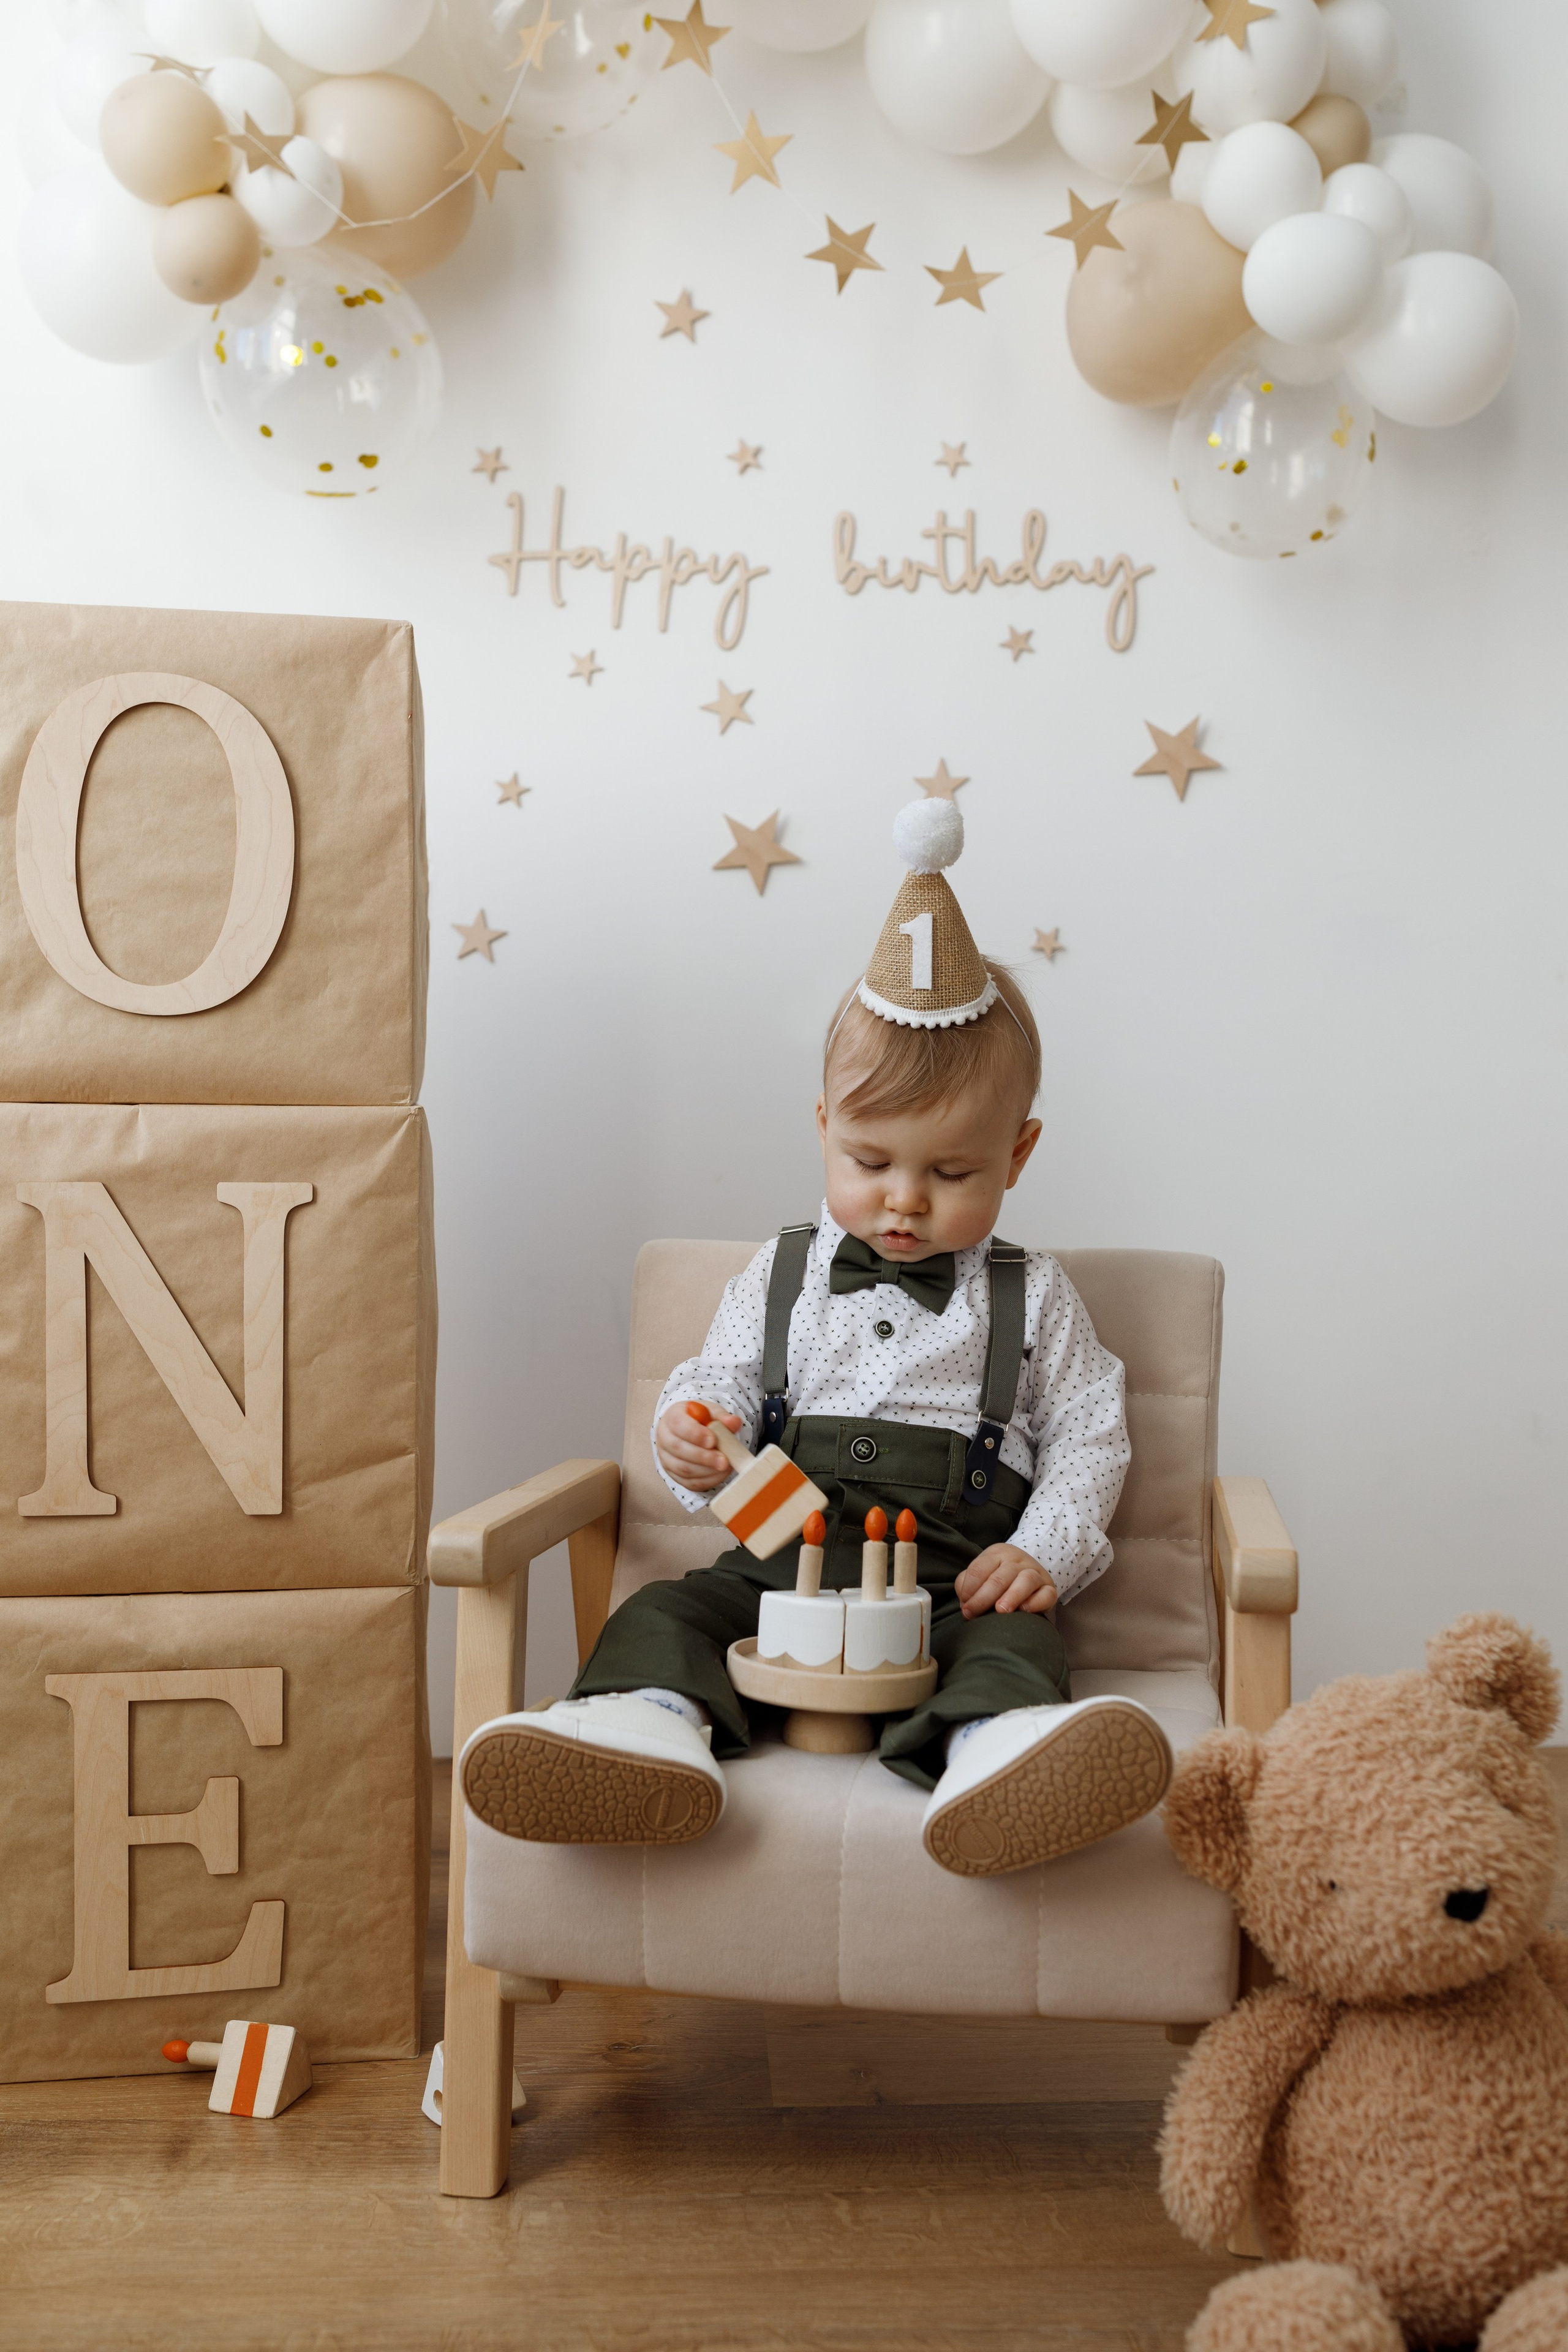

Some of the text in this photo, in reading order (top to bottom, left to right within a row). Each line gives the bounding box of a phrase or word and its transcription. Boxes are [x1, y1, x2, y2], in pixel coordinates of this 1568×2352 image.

[489, 486, 1154, 652] Happy birthday
[899, 913, 933, 990] 1
